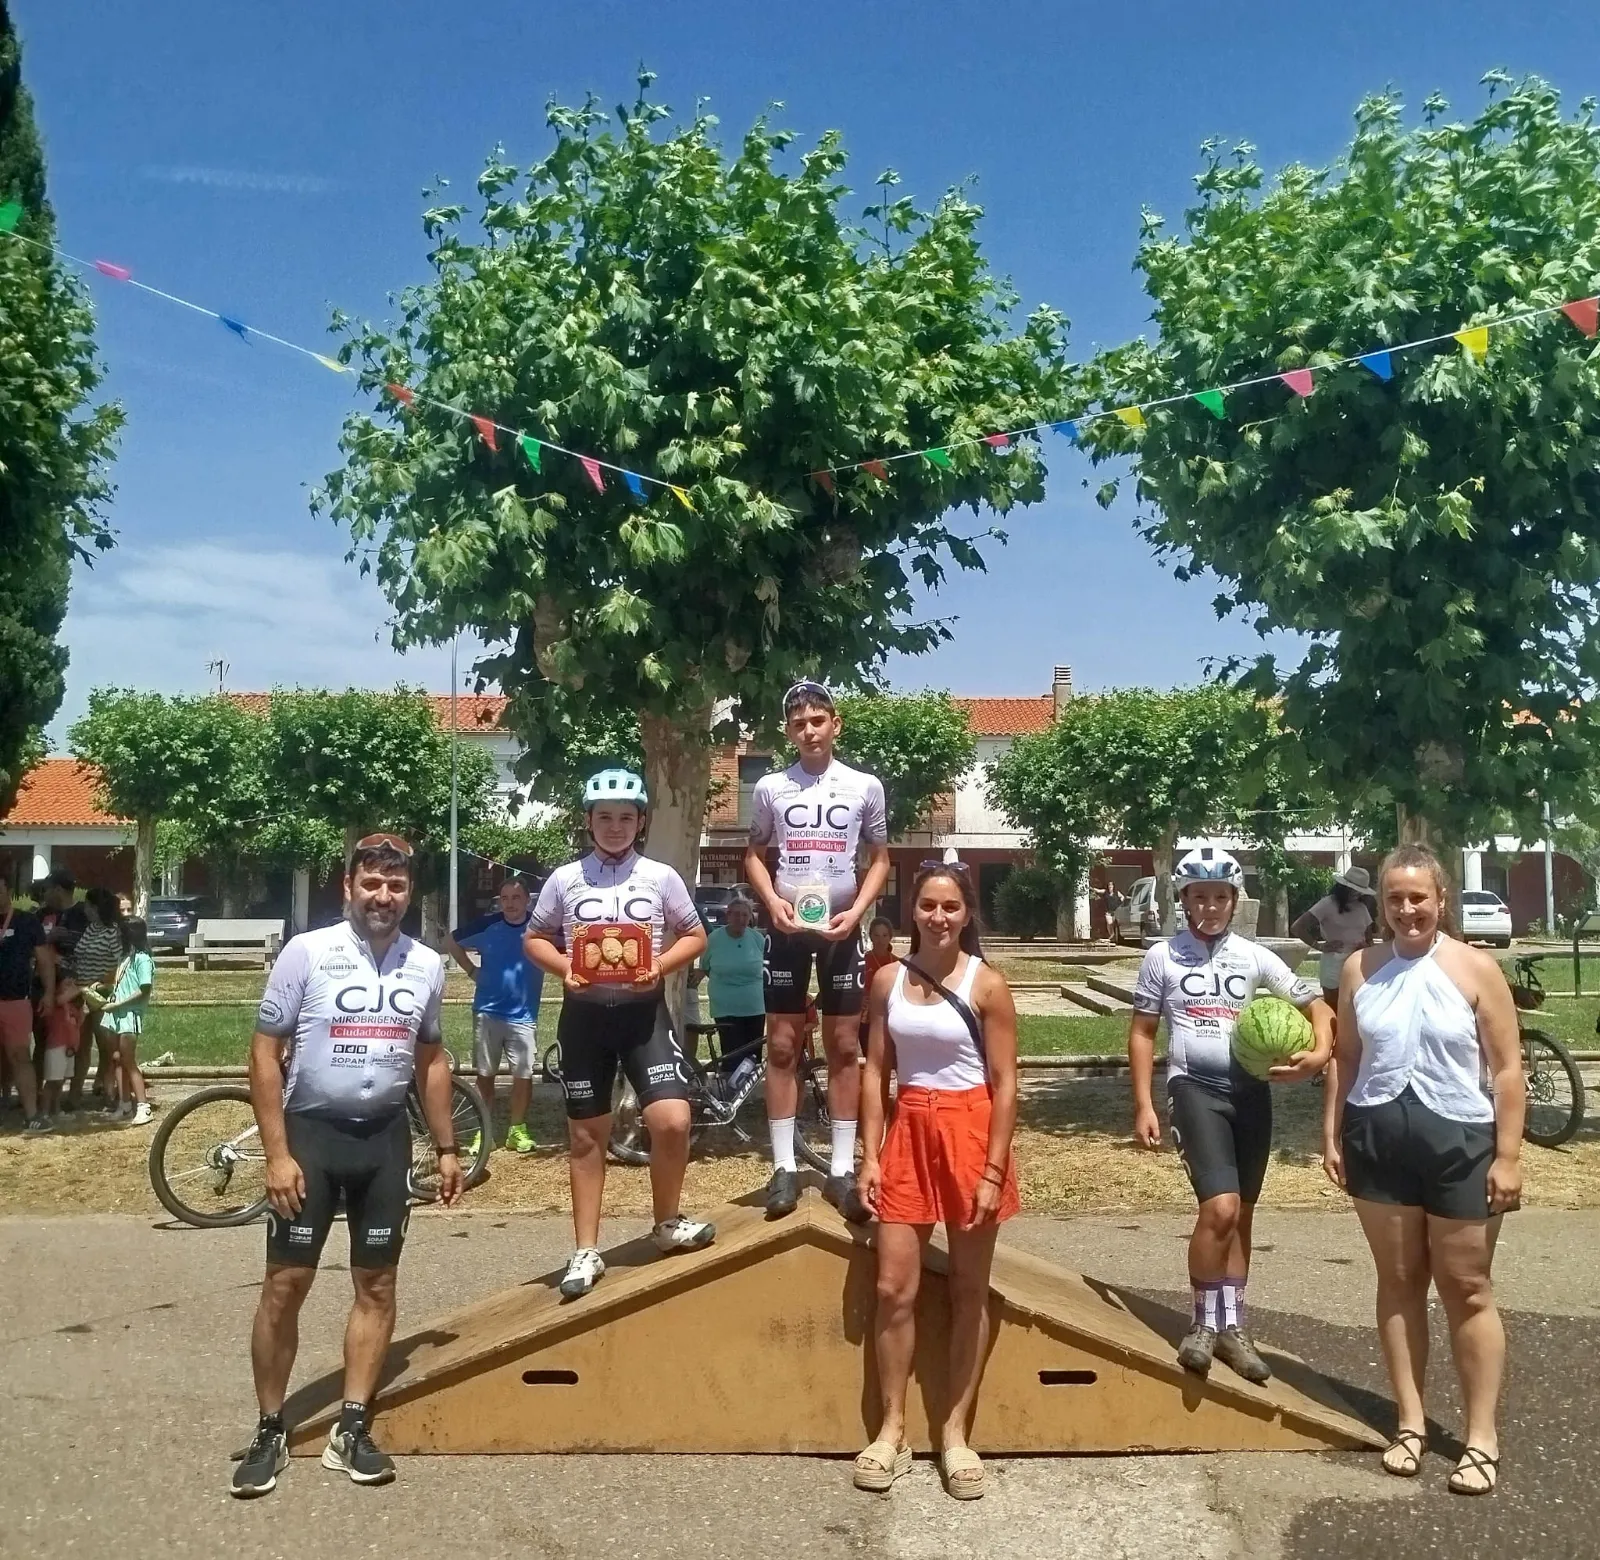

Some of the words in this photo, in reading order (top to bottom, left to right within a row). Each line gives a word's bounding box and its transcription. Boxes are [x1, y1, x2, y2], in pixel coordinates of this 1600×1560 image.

[784, 804, 850, 830] CJC
[786, 830, 848, 839] MIROBRIGENSES
[788, 841, 813, 849] Ciudad
[815, 841, 845, 852] Rodrigo
[574, 897, 653, 922] CJC
[1180, 973, 1246, 1000] CJC
[335, 984, 415, 1016] CJC
[332, 1015, 413, 1026] MIROBRIGENSES
[334, 1027, 372, 1037] Ciudad
[374, 1028, 409, 1039] Rodrigo
